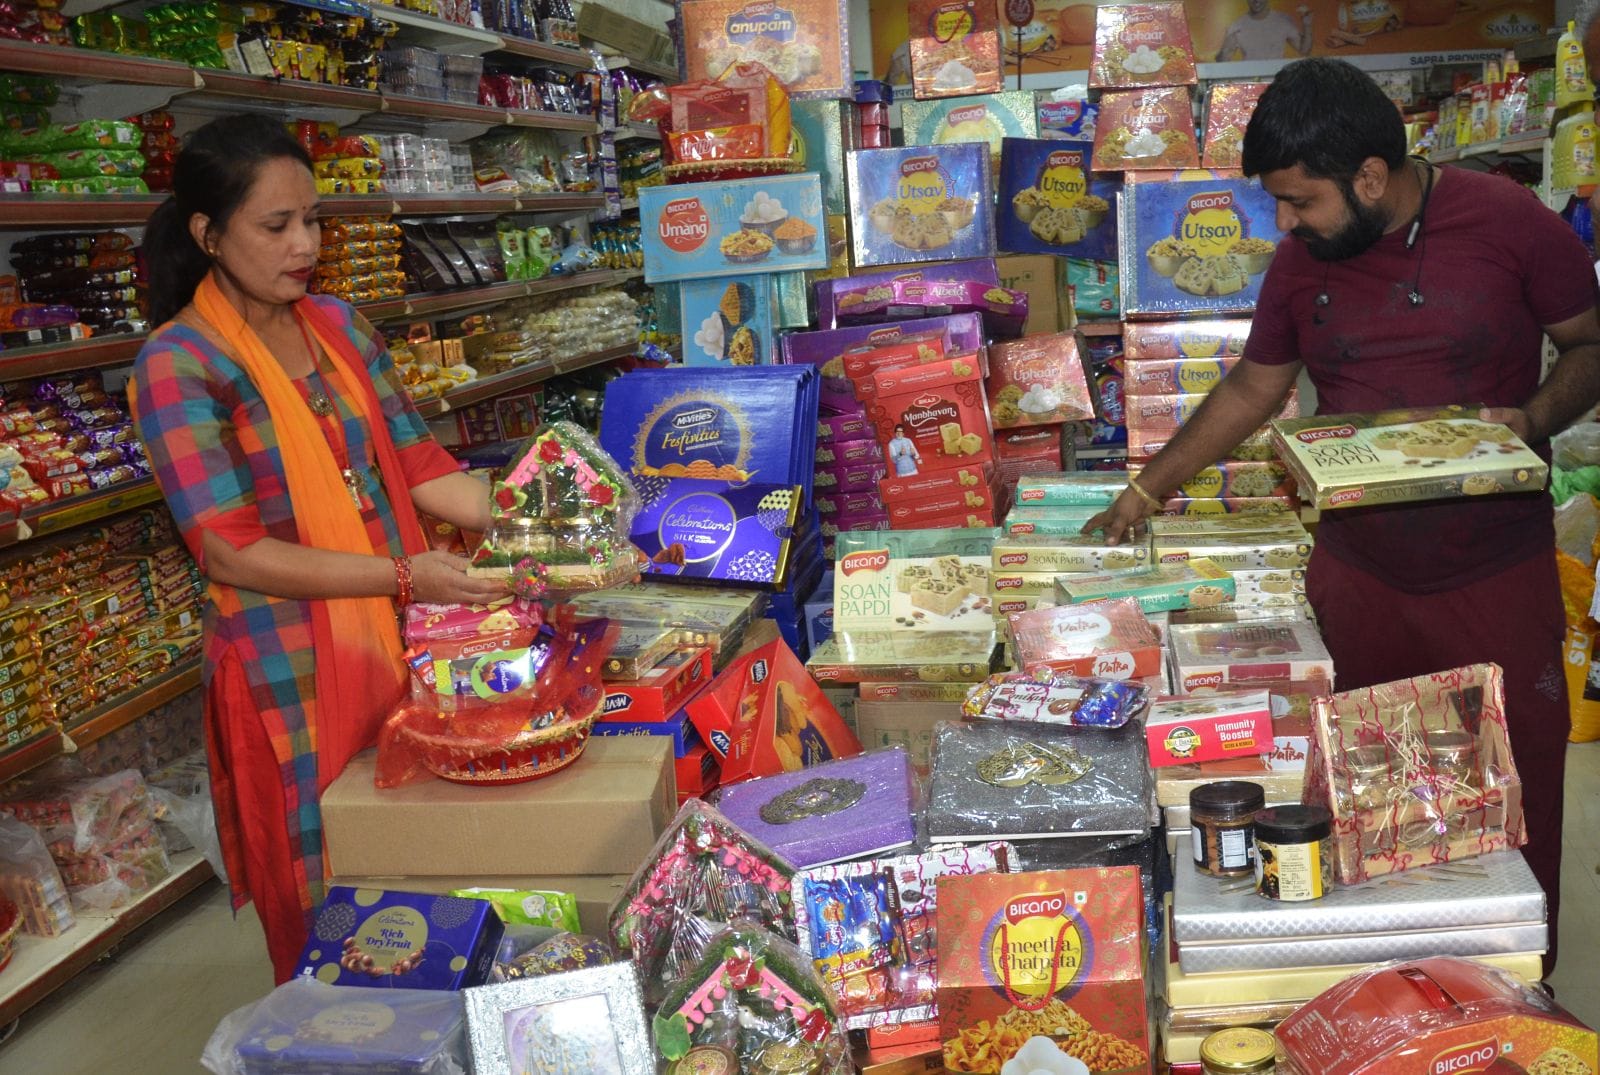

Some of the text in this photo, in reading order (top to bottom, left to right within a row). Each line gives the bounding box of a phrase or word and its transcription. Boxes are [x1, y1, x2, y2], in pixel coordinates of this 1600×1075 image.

[1486, 23, 1542, 34] SANTOOR
[1410, 55, 1444, 65] SAPRA
[899, 182, 943, 199] Utsav
[1043, 175, 1084, 194] Utsav
[1184, 221, 1239, 240] Utsav
[665, 512, 734, 532] Celebrations
[840, 582, 891, 599] SOAN
[840, 600, 891, 617] PAPDI
[1214, 719, 1256, 733] Immunity
[1219, 730, 1254, 742] Booster
[379, 928, 405, 939] Rich
[365, 936, 412, 949] Dry Fruit
